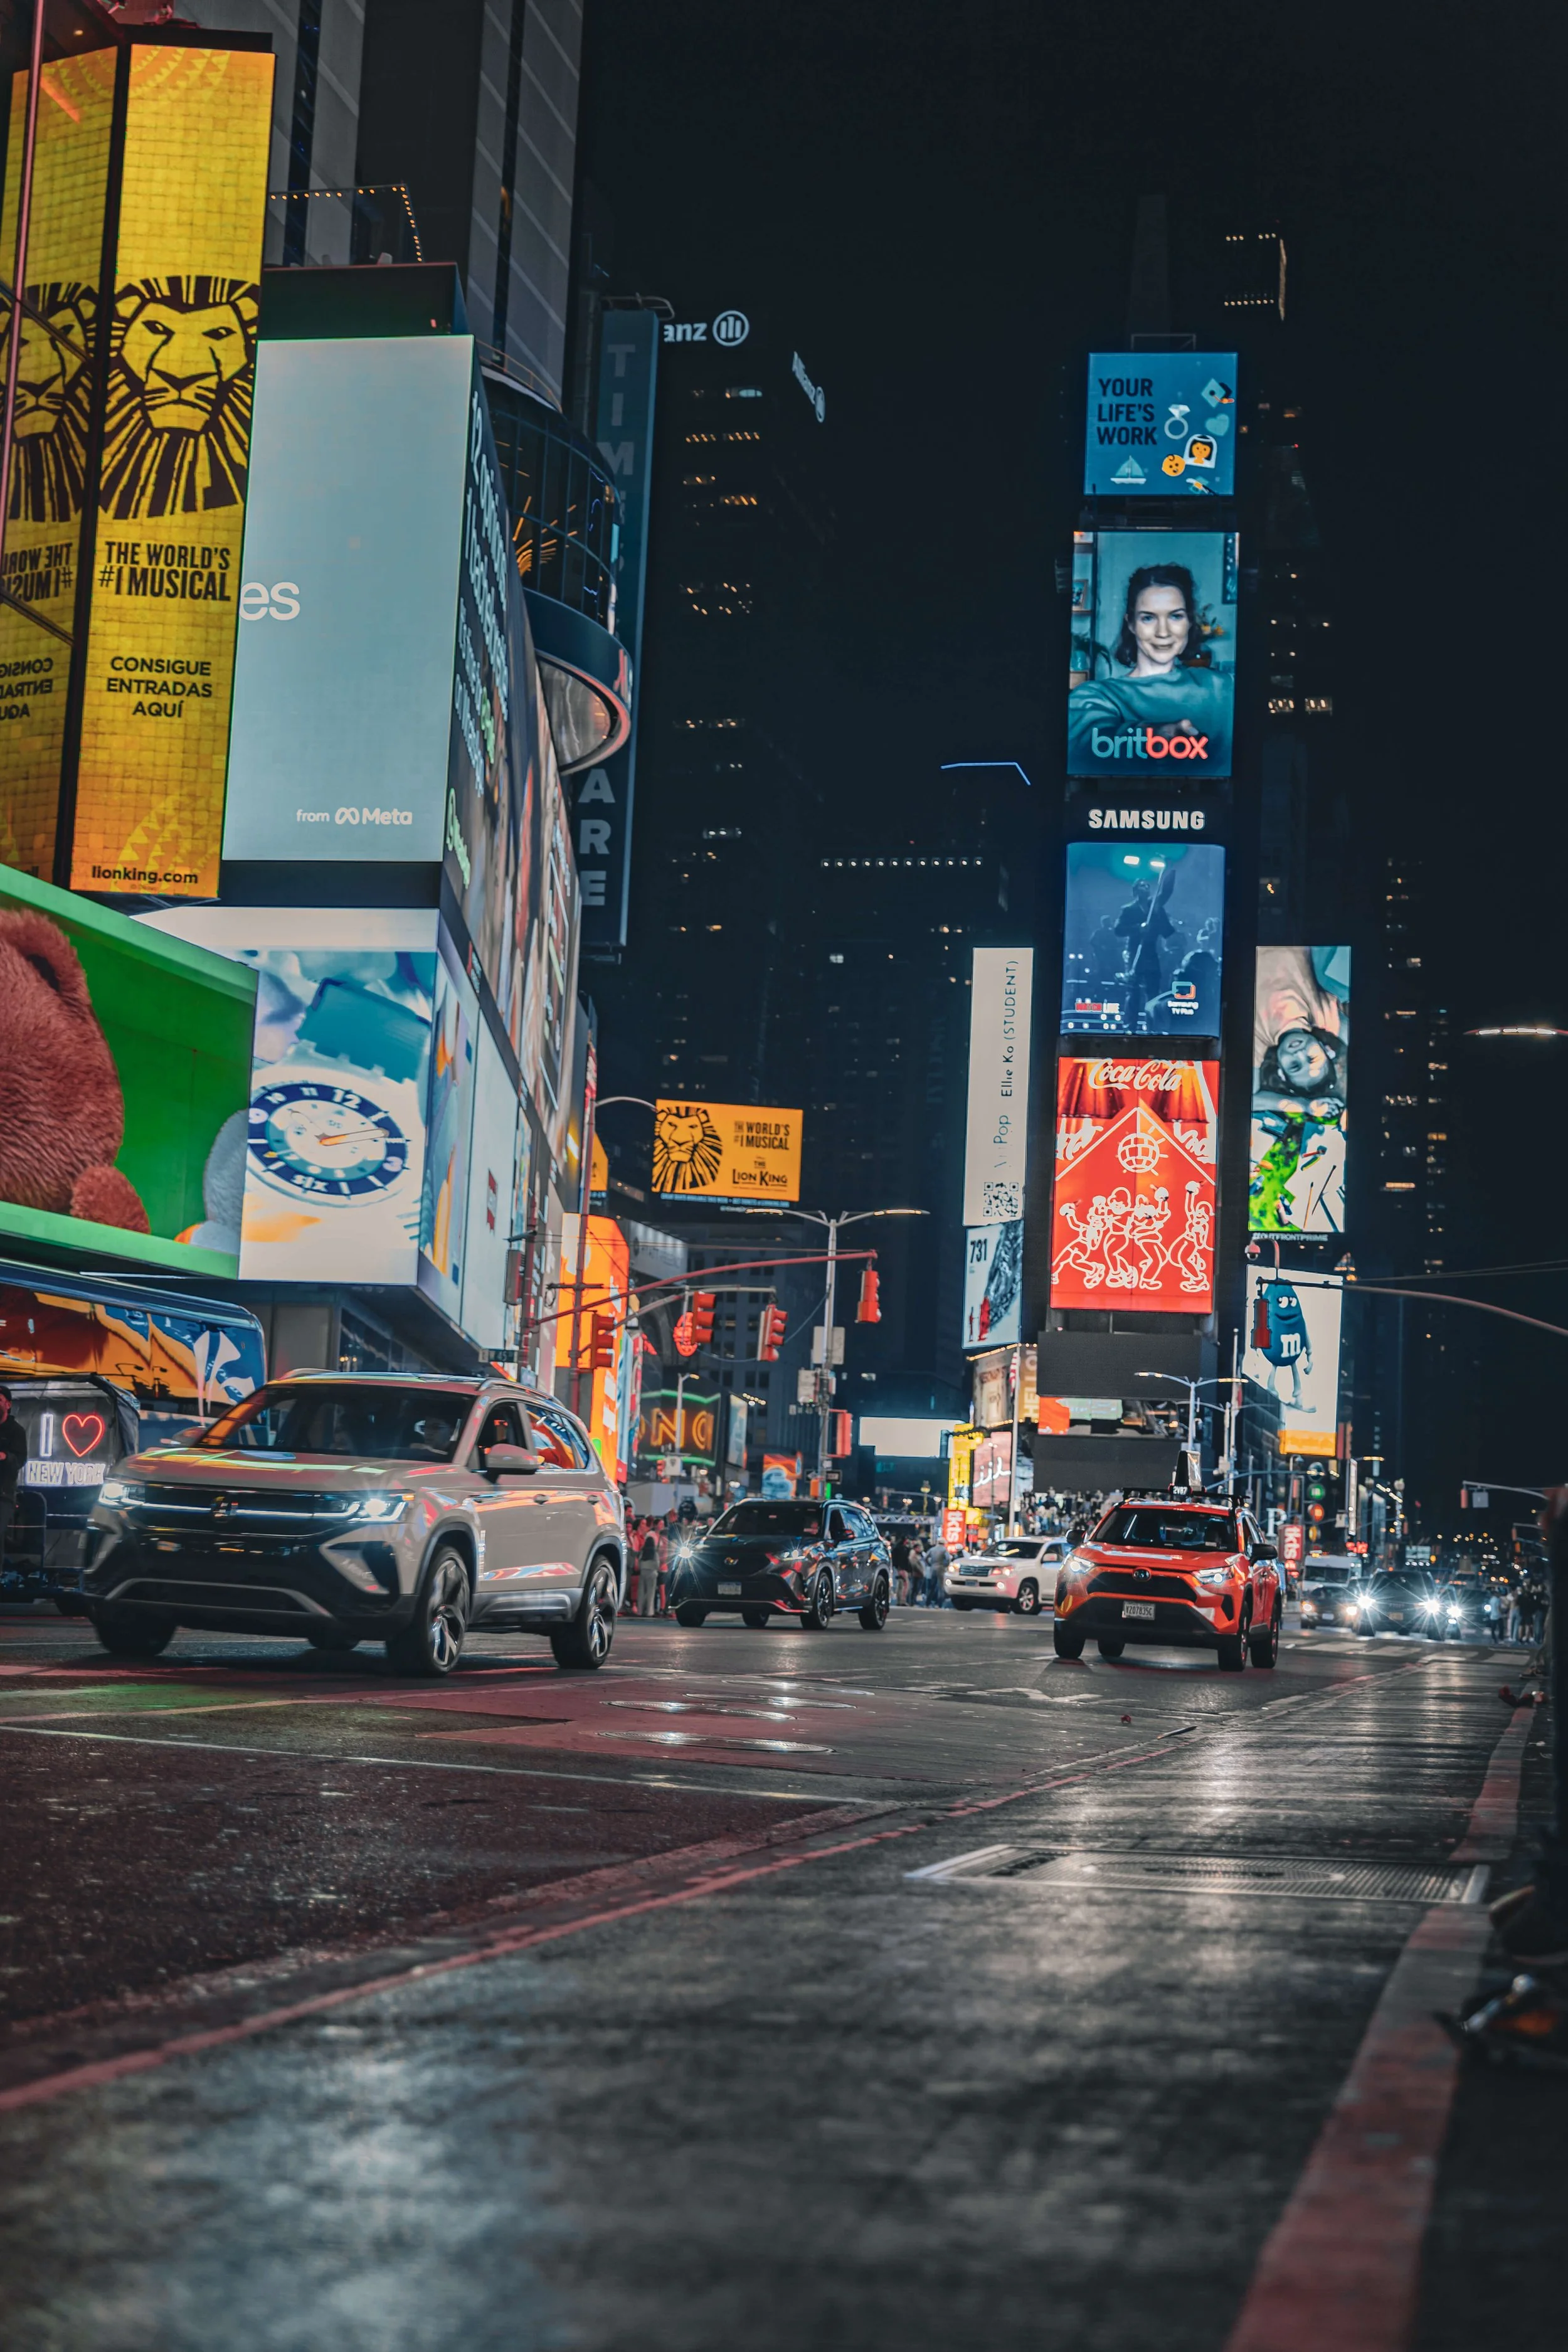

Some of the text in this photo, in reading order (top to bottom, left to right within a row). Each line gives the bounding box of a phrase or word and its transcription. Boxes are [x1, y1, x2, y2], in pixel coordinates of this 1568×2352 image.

[1098, 378, 1153, 396] YOUR
[1098, 403, 1155, 422] LIFE'S
[1097, 426, 1157, 445] WORK
[105, 541, 230, 570] THE WORLD'S
[98, 565, 231, 601] #1 MUSICAL
[240, 582, 300, 621] es
[110, 656, 211, 676] CONSIGUE
[106, 677, 213, 698] ENTRADAS
[132, 700, 184, 718] AQUÍ
[1091, 728, 1209, 760] britbox
[297, 808, 413, 825] from Meta
[1088, 808, 1205, 830] SAMSUNG
[91, 865, 199, 884] lionking.com
[1004, 960, 1019, 1041] (STUDENT)
[1002, 1045, 1014, 1064] Ko
[1001, 1069, 1013, 1098] Ellie
[1088, 1058, 1183, 1091] Coca-Cola
[332, 1089, 361, 1109] 12
[746, 1121, 790, 1136] WORLD'S
[746, 1136, 790, 1150] MUSICAL
[970, 1238, 988, 1264] 731
[1280, 1333, 1301, 1358] m
[40, 1413, 54, 1458] I
[26, 1460, 106, 1485] NEW YORK
[946, 1510, 963, 1542] tkts
[1284, 1526, 1301, 1560] tkts
